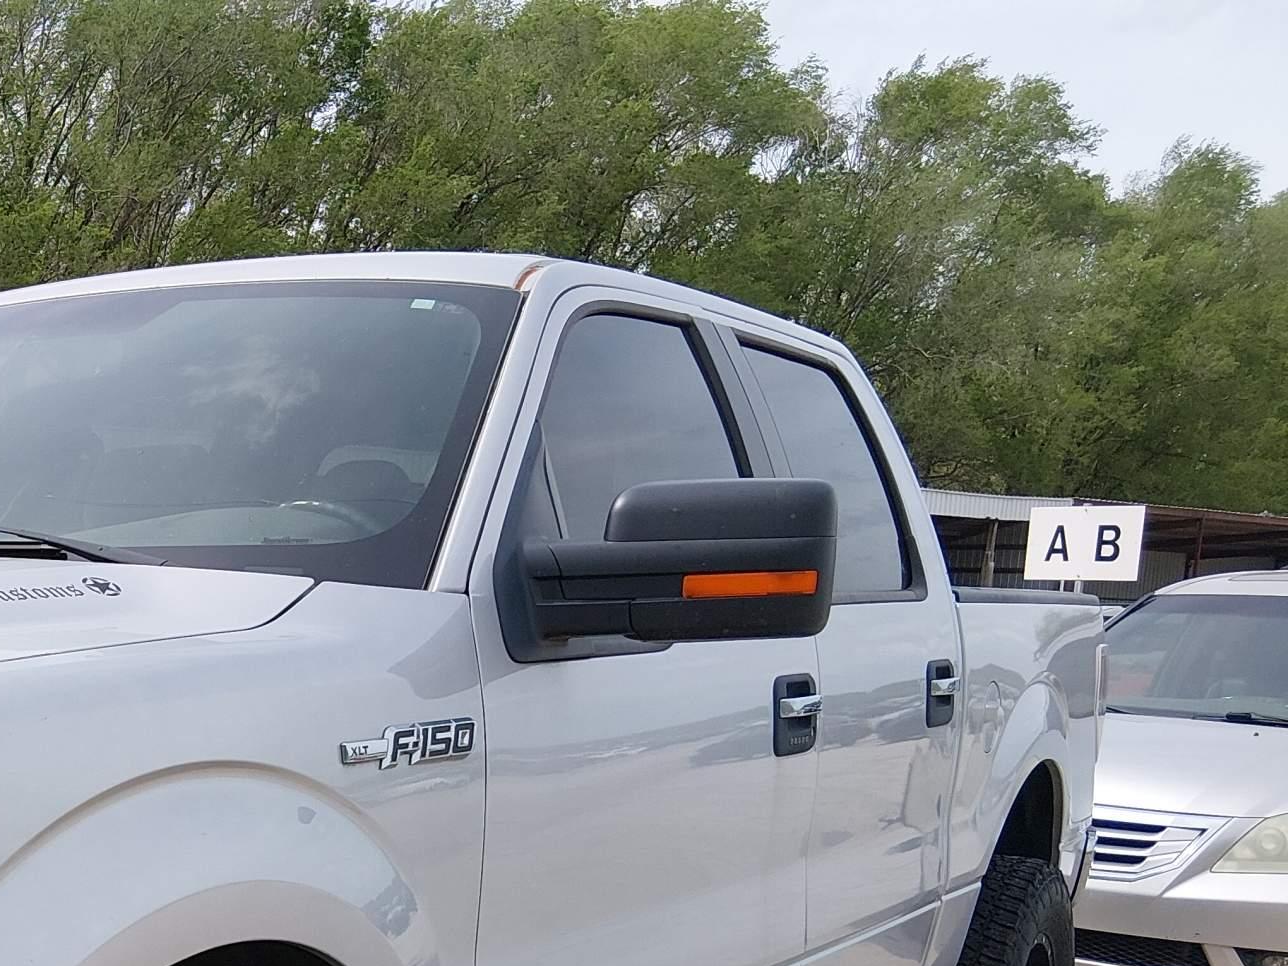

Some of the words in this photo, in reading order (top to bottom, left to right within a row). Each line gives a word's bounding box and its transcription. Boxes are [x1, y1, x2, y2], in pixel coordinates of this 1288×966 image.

[1044, 525, 1069, 562] A
[1094, 525, 1122, 562] B
[350, 745, 369, 758] XLT
